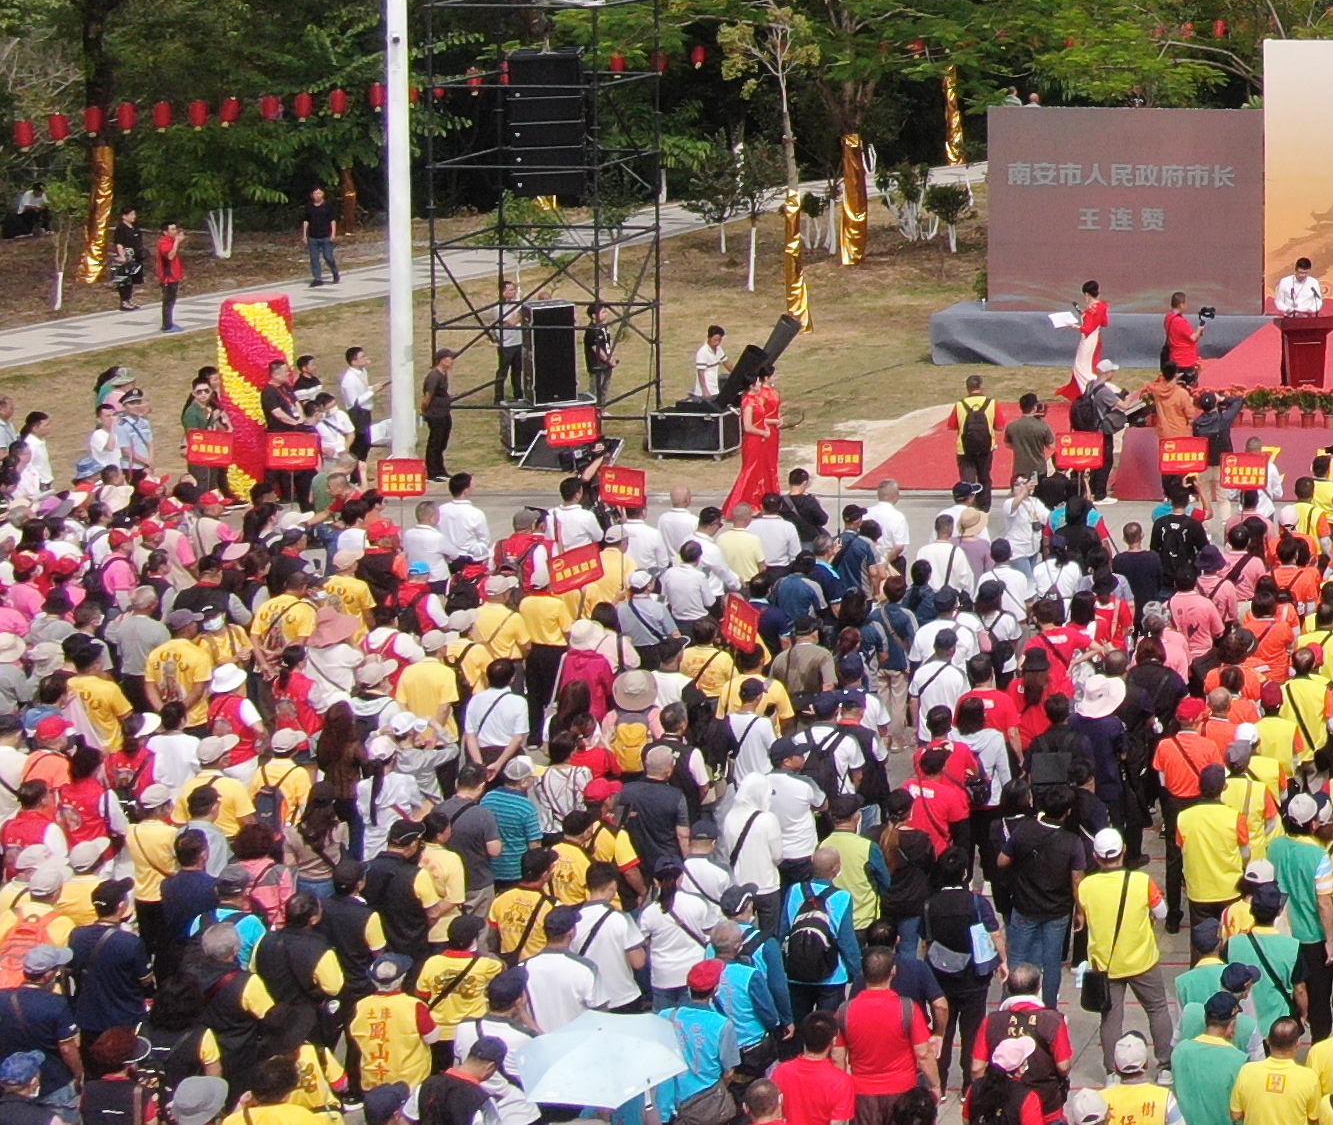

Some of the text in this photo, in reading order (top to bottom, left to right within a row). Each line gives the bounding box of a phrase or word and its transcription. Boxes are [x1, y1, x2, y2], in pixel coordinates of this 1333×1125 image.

[1007, 162, 1235, 188] 南安市人民政府市长
